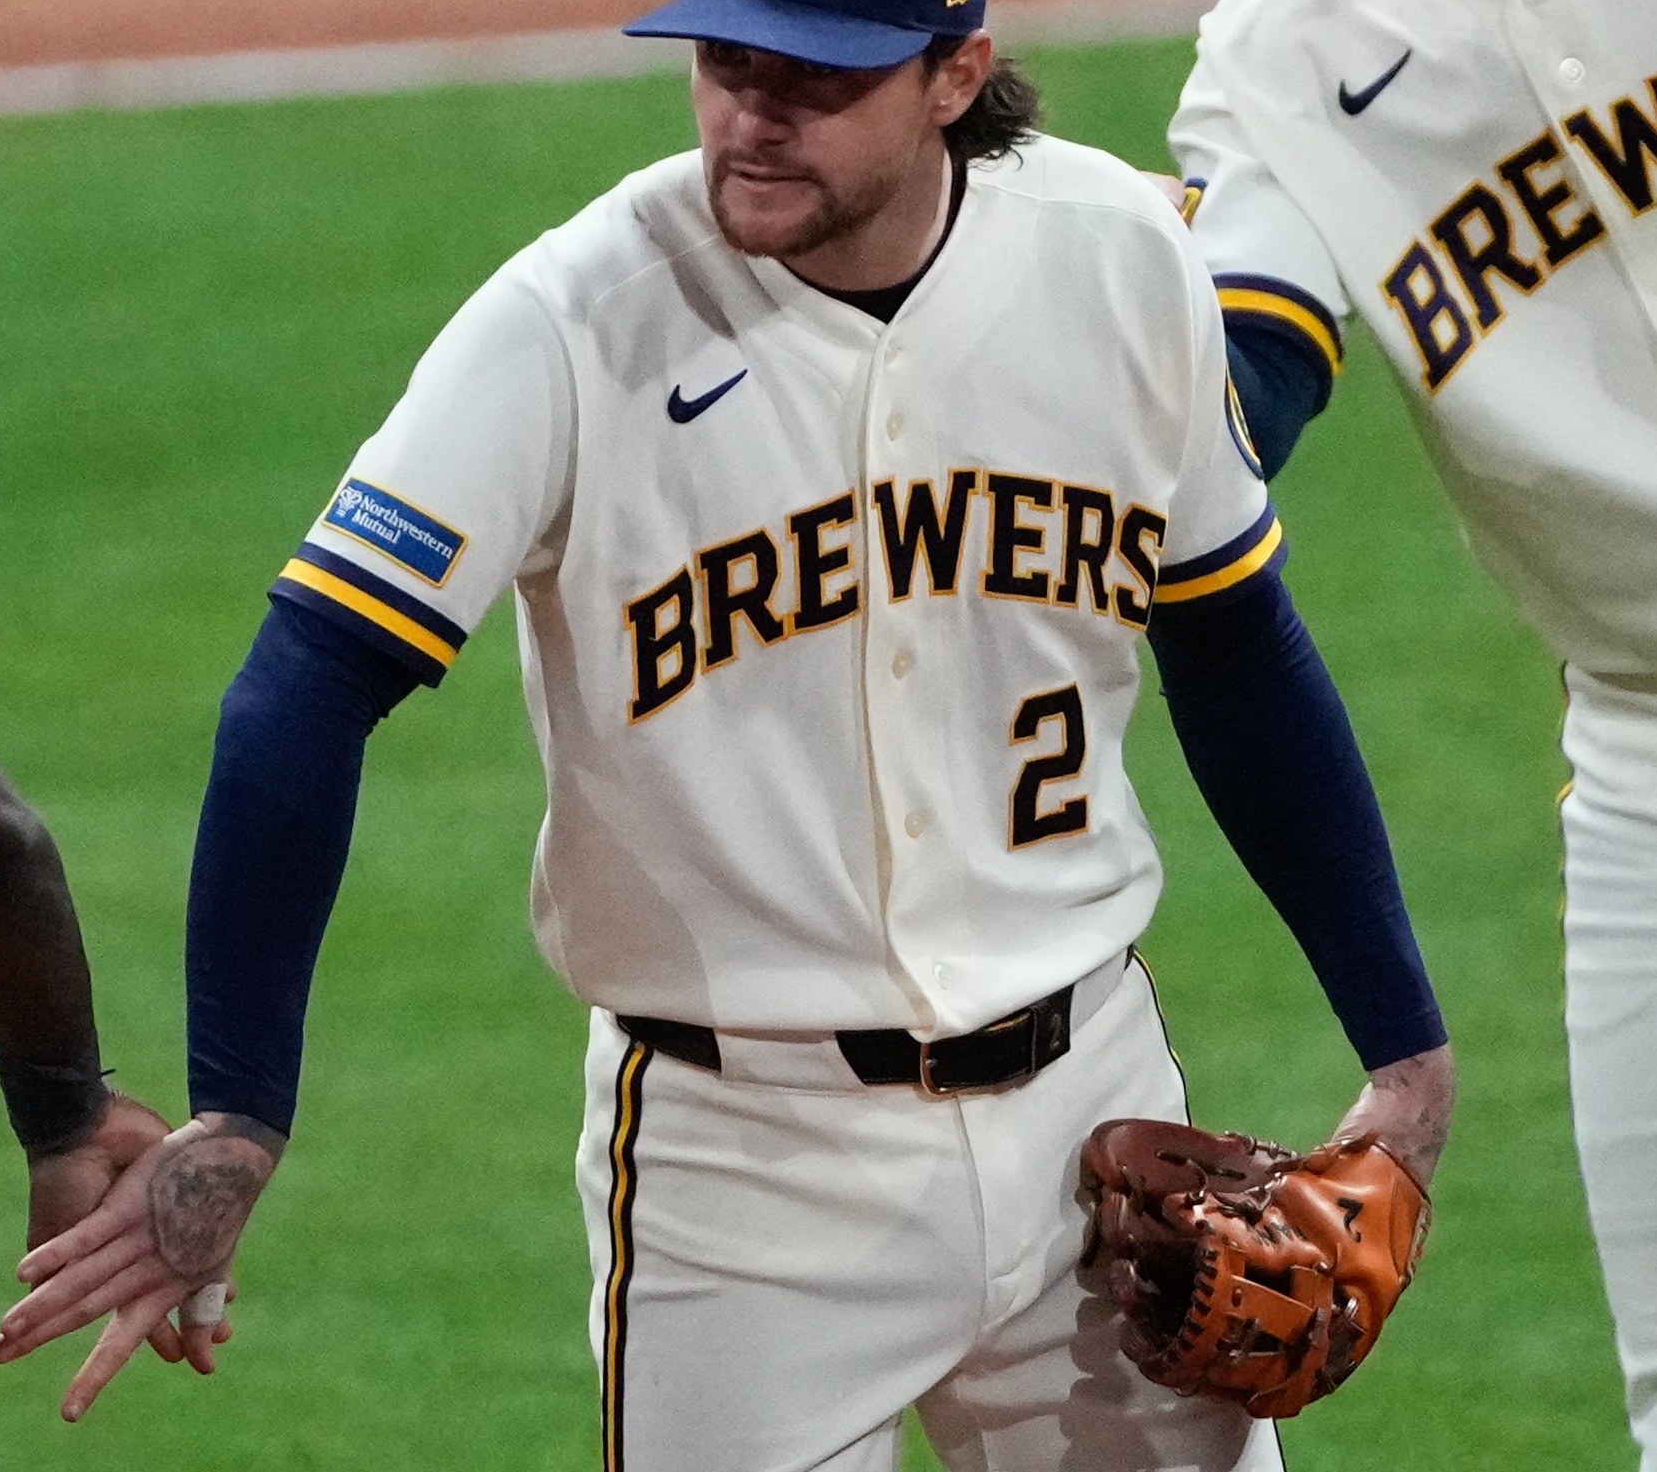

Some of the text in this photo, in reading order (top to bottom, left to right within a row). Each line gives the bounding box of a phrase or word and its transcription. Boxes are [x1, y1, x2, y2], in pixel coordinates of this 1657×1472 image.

[352, 508, 402, 545] Mutual
[360, 495, 454, 560] Northwestern
[622, 468, 1167, 724] BREWERS
[1008, 682, 1090, 851] 2
